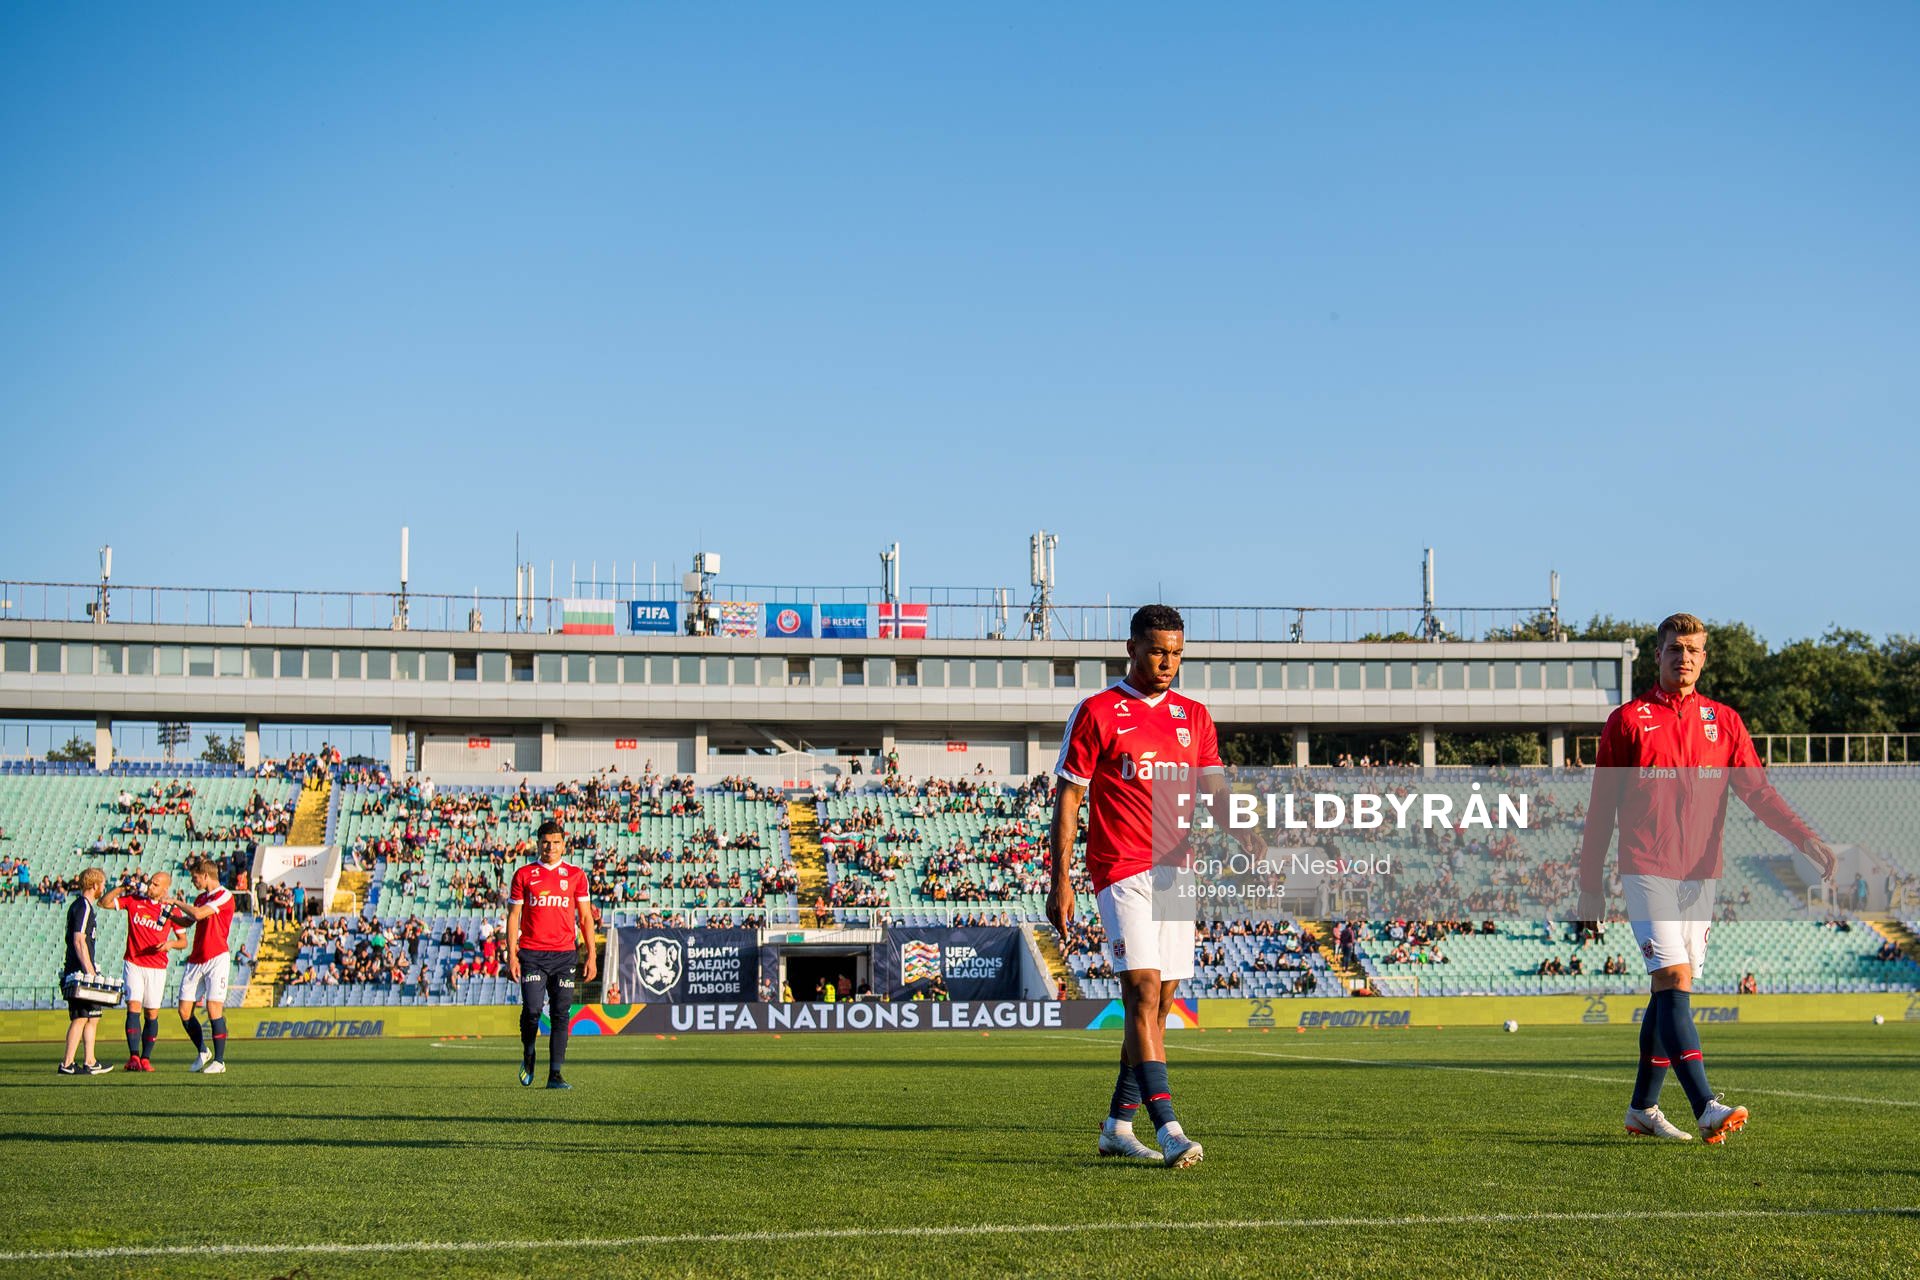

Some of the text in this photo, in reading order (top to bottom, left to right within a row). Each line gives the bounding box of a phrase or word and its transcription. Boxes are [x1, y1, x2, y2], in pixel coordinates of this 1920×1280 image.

[637, 606, 670, 620] FIFA
[832, 617, 866, 626] RESPECT
[1121, 752, 1190, 781] bama
[1639, 766, 1677, 779] bama
[529, 891, 569, 908] bama
[687, 947, 739, 958] ВИНАГИ
[945, 946, 978, 958] UEFA
[688, 958, 741, 971] ЗАЕДНО
[945, 957, 1003, 968] NATIONS
[688, 971, 739, 982] ВИНАГИ
[946, 967, 996, 978] LEAGUE
[220, 977, 226, 990] 5
[688, 982, 741, 994] ЛЪВОВЕ
[1250, 999, 1274, 1018] 25
[671, 1002, 1063, 1031] UEFA NATIONS LEAGUE
[1299, 1010, 1411, 1027] ЕВРОФУТБОЛ
[256, 1019, 385, 1038] ЕВРОФУТБОЛ
